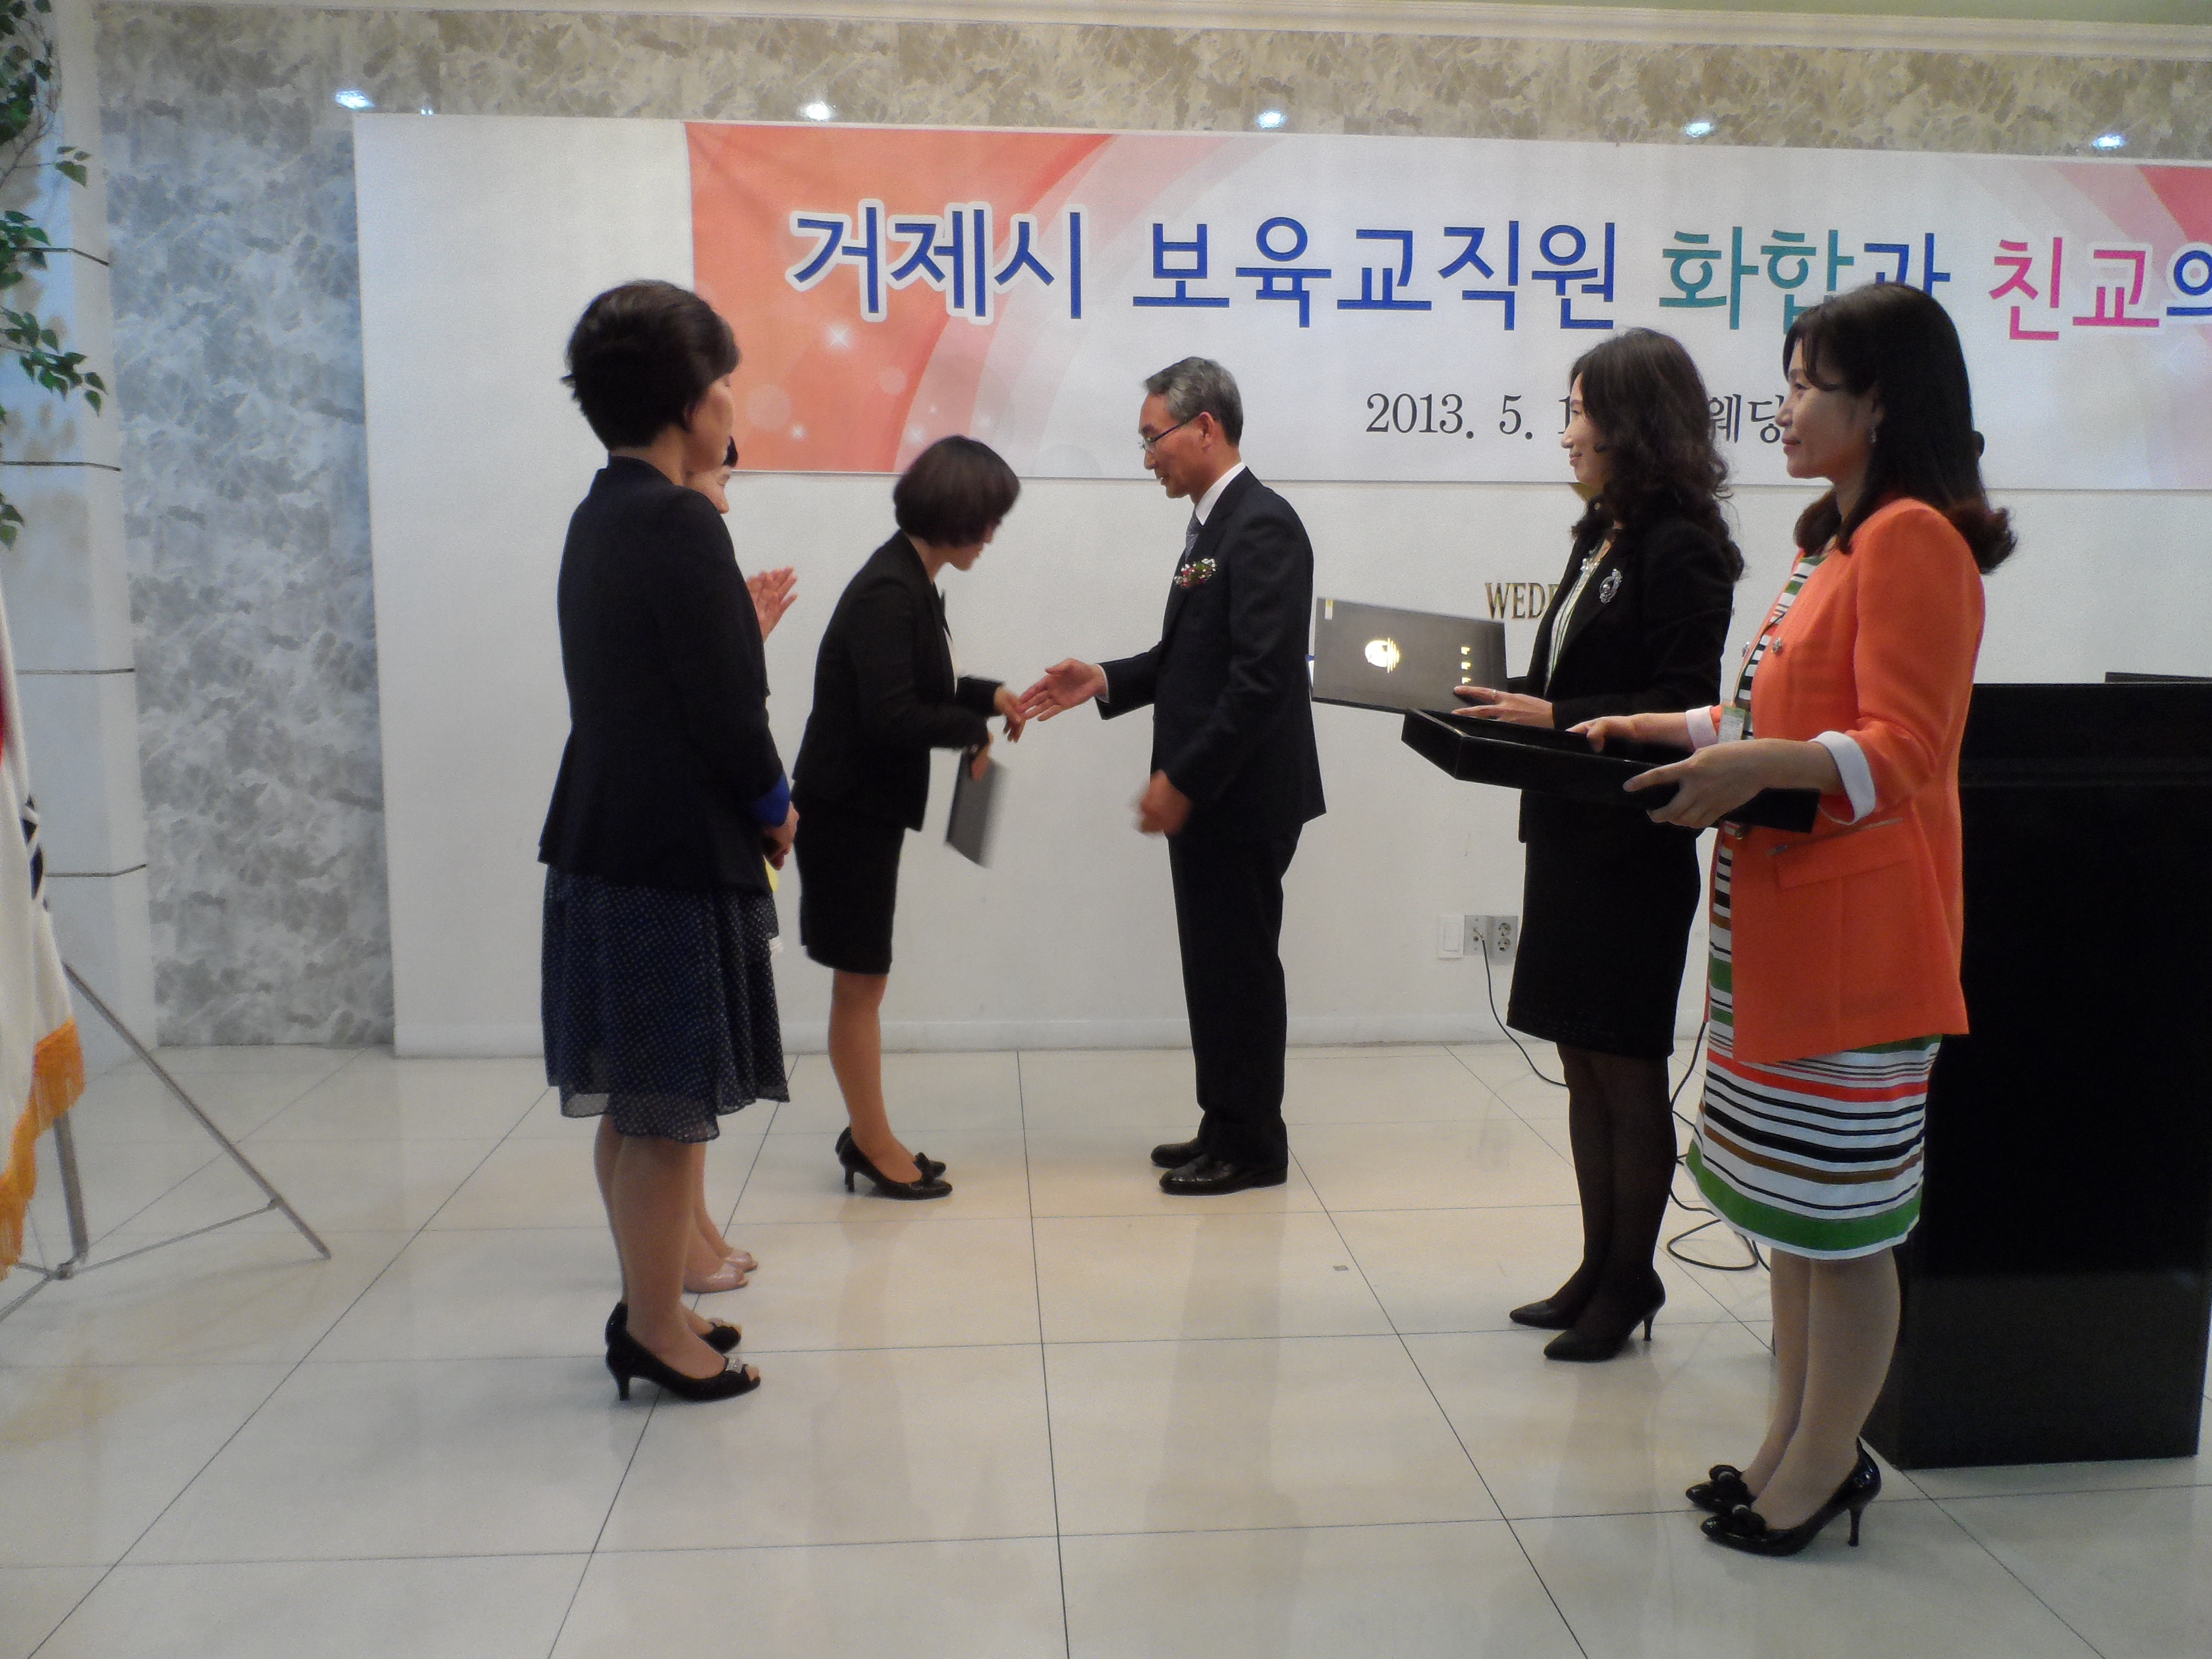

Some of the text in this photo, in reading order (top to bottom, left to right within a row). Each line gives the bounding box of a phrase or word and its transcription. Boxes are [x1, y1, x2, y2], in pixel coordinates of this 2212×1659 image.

[793, 206, 1082, 319] 거제시
[1132, 217, 1616, 331] 보육교직원
[1366, 393, 1474, 439] 2013.
[1499, 394, 1533, 440] 5.
